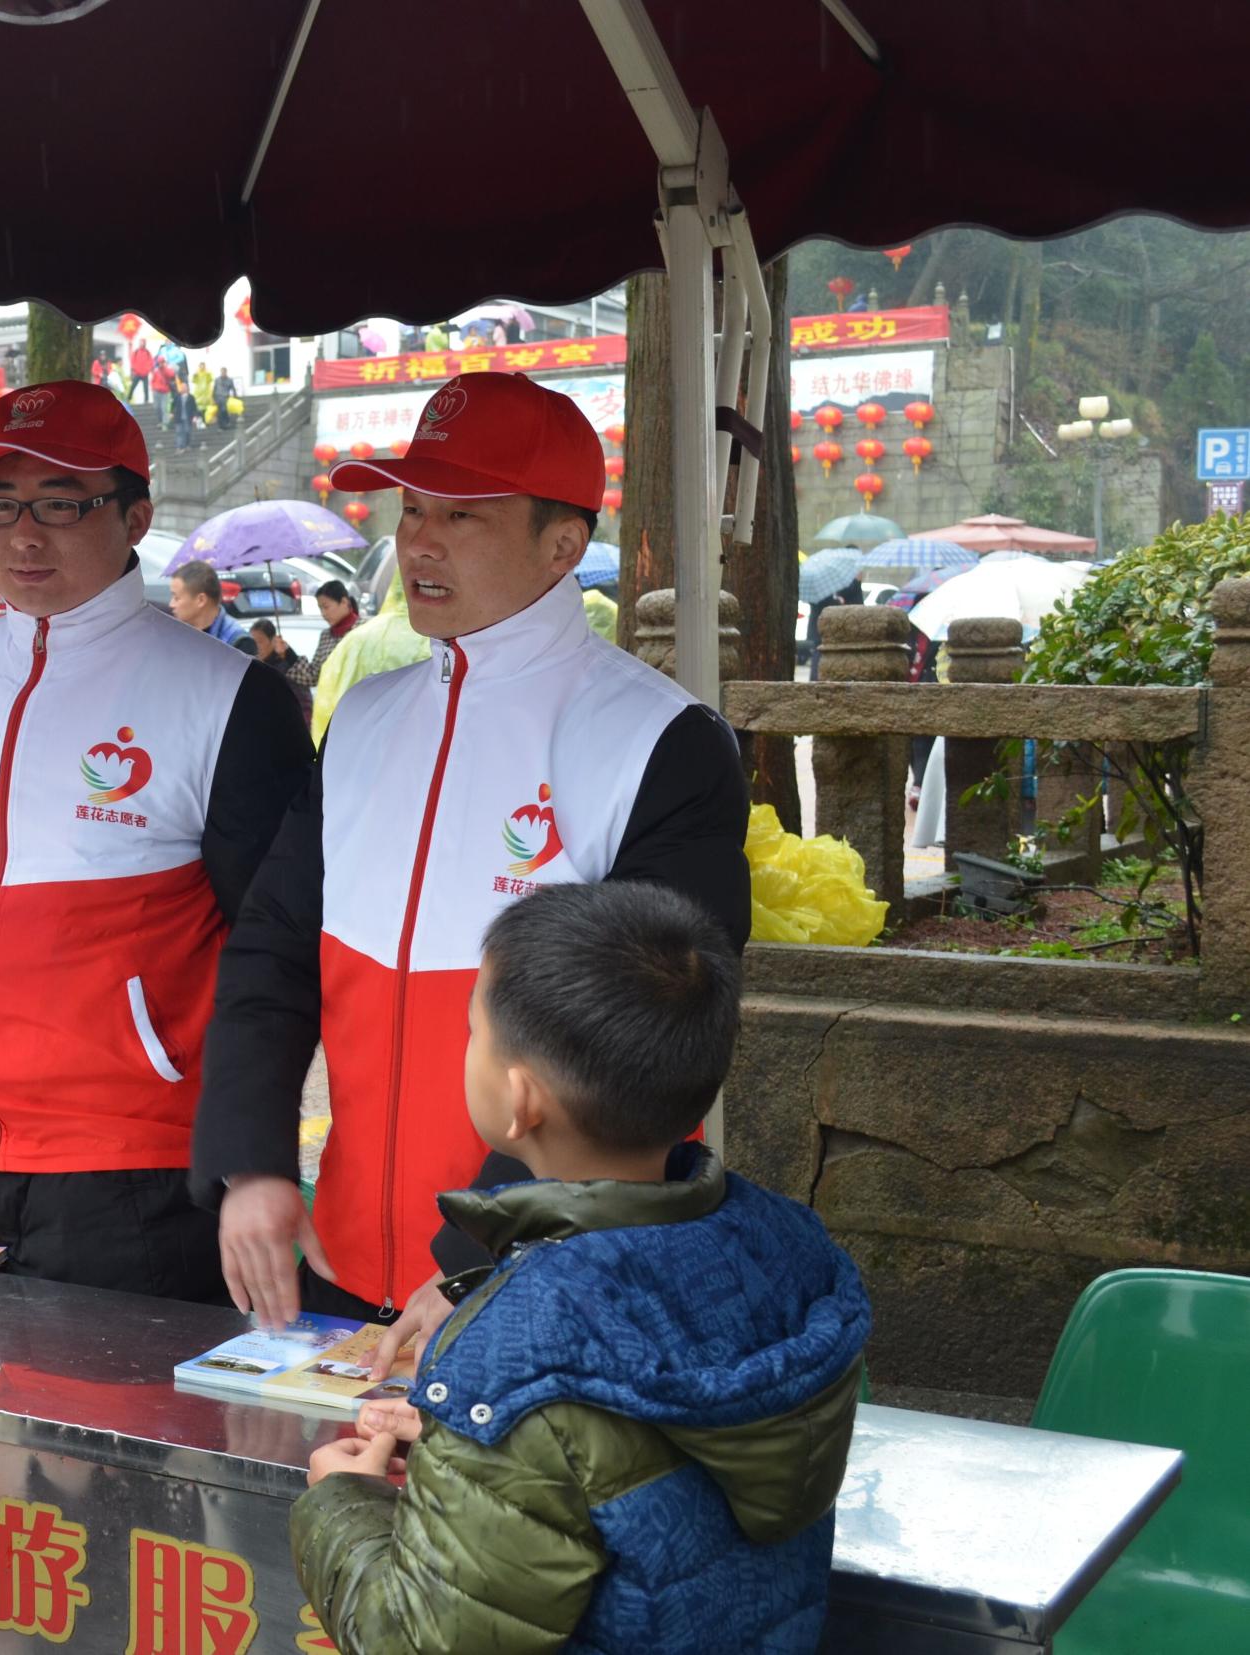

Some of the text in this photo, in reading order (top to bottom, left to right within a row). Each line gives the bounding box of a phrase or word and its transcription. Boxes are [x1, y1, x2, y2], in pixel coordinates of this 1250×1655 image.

[790, 315, 897, 347] 成功
[359, 343, 597, 382] 祈福百岁宫
[1205, 437, 1230, 470] P
[75, 804, 149, 828] 莲花志愿者
